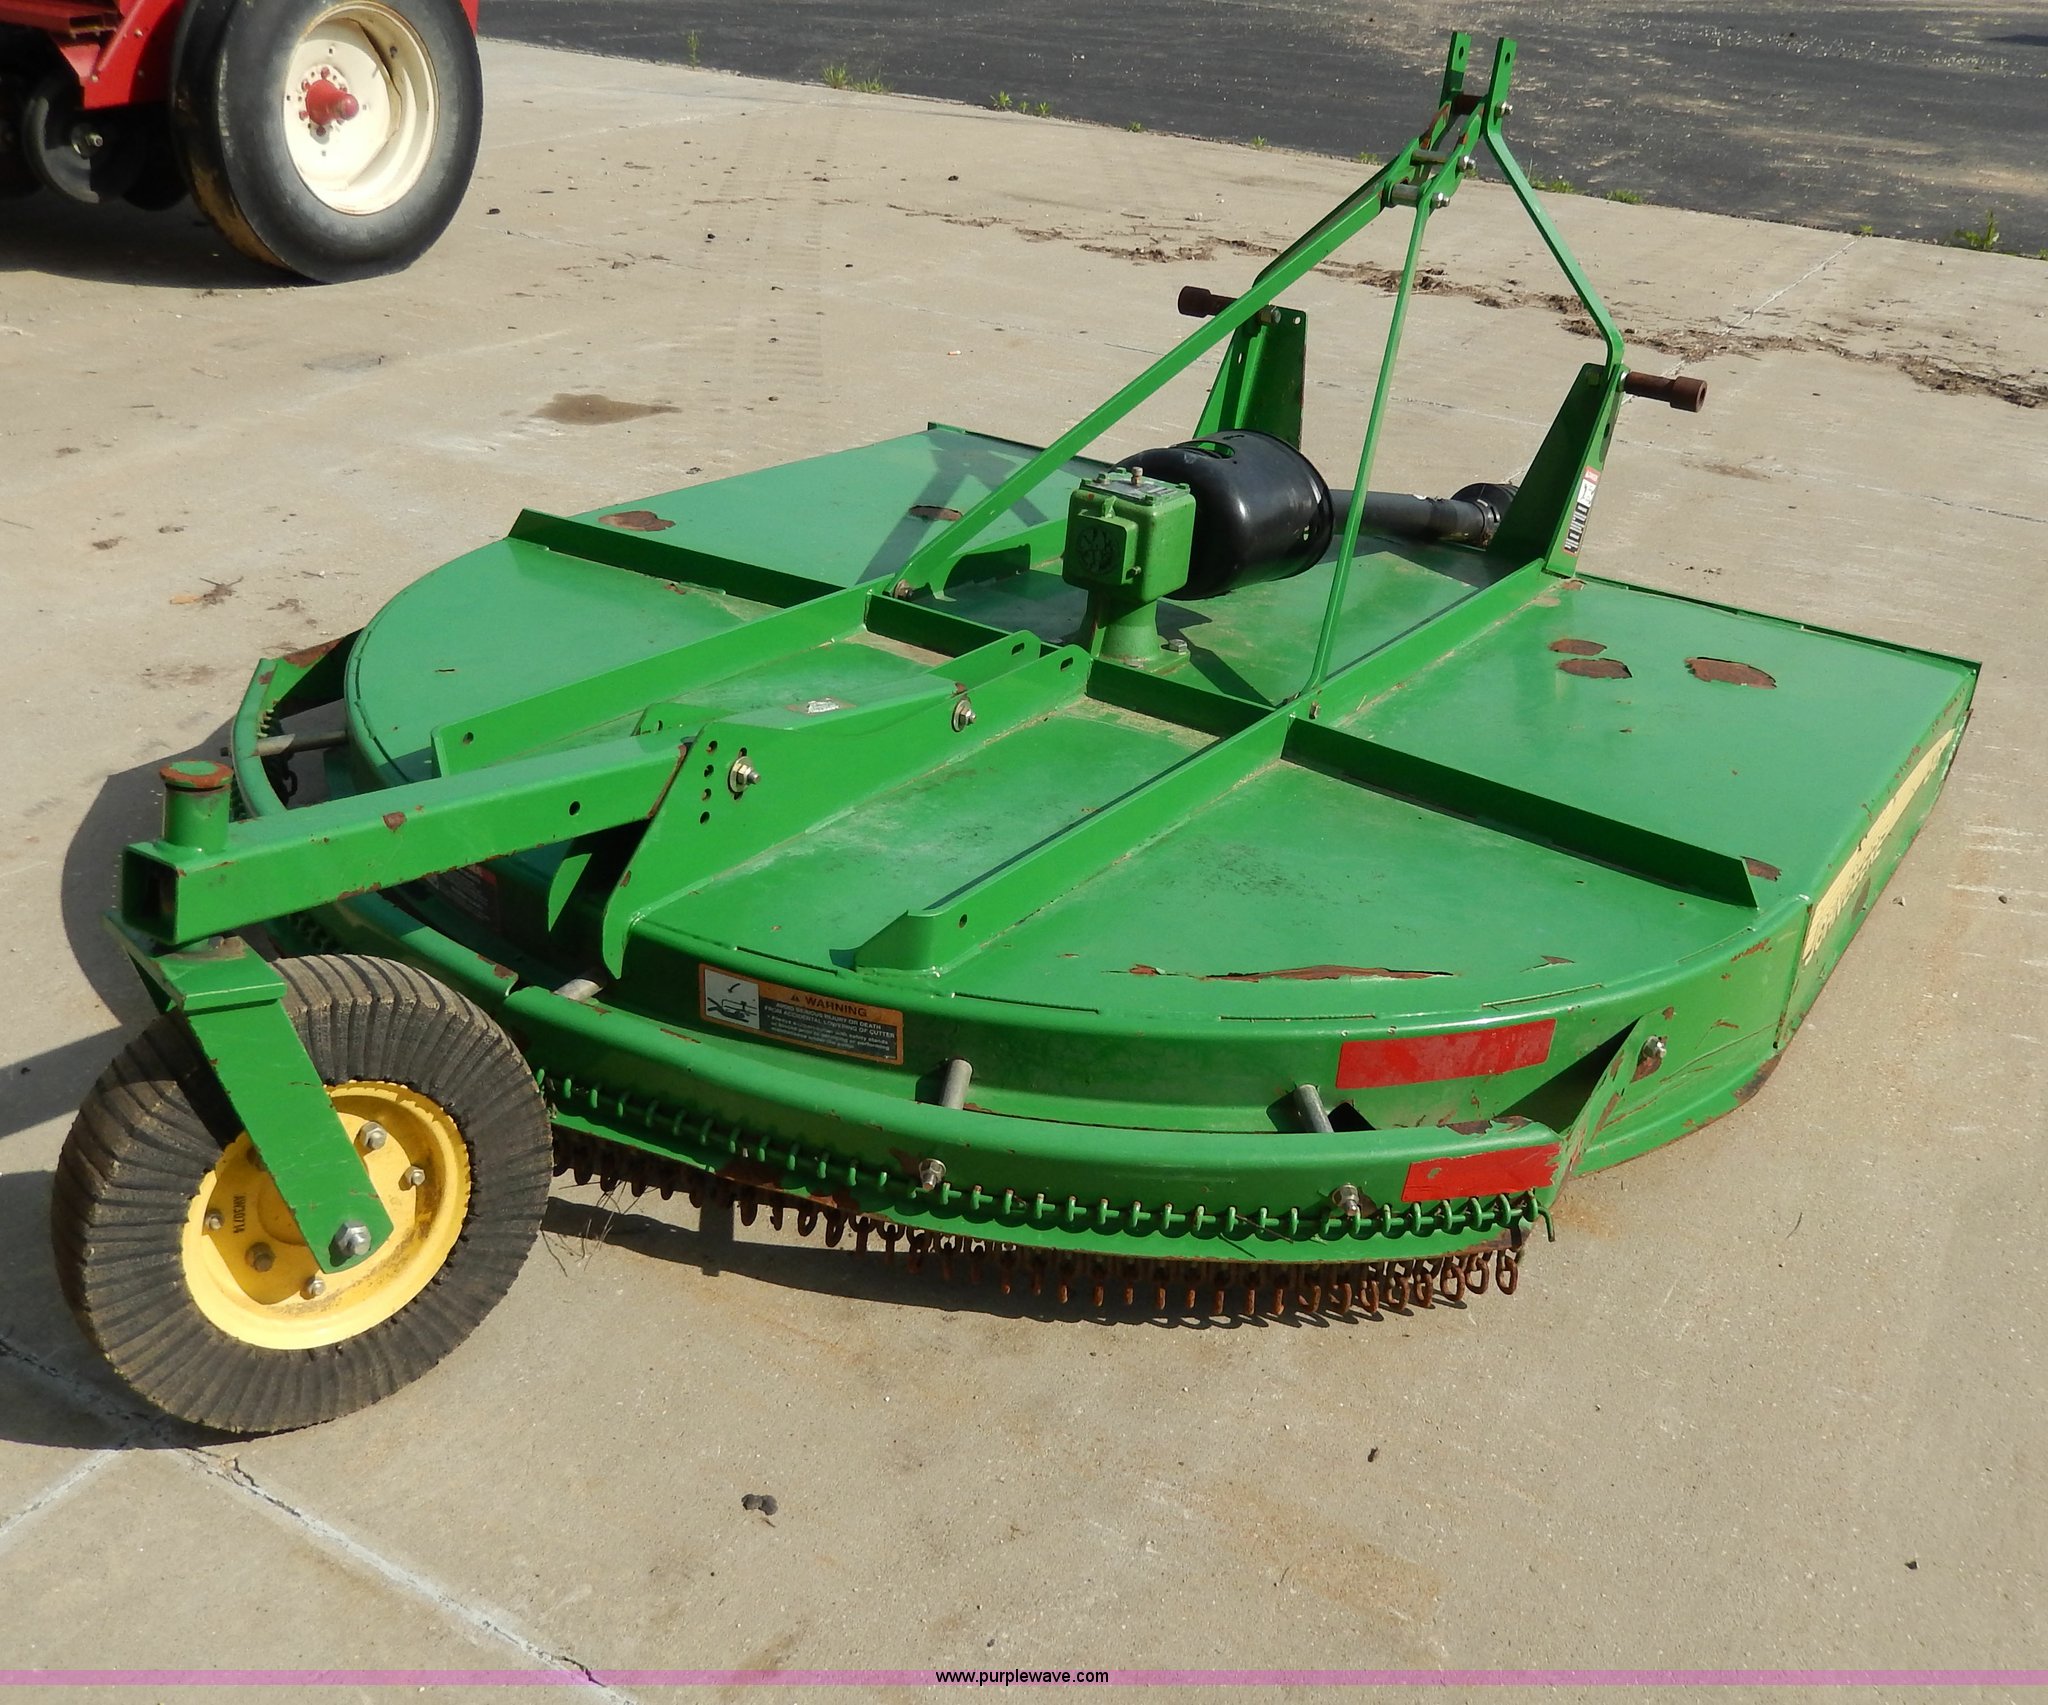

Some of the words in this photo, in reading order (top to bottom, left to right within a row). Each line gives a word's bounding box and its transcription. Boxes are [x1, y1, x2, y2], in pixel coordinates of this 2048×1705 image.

[805, 996, 867, 1017] WARNING
[860, 1021, 881, 1030] DEATH
[869, 1029, 895, 1039] CUTTER
